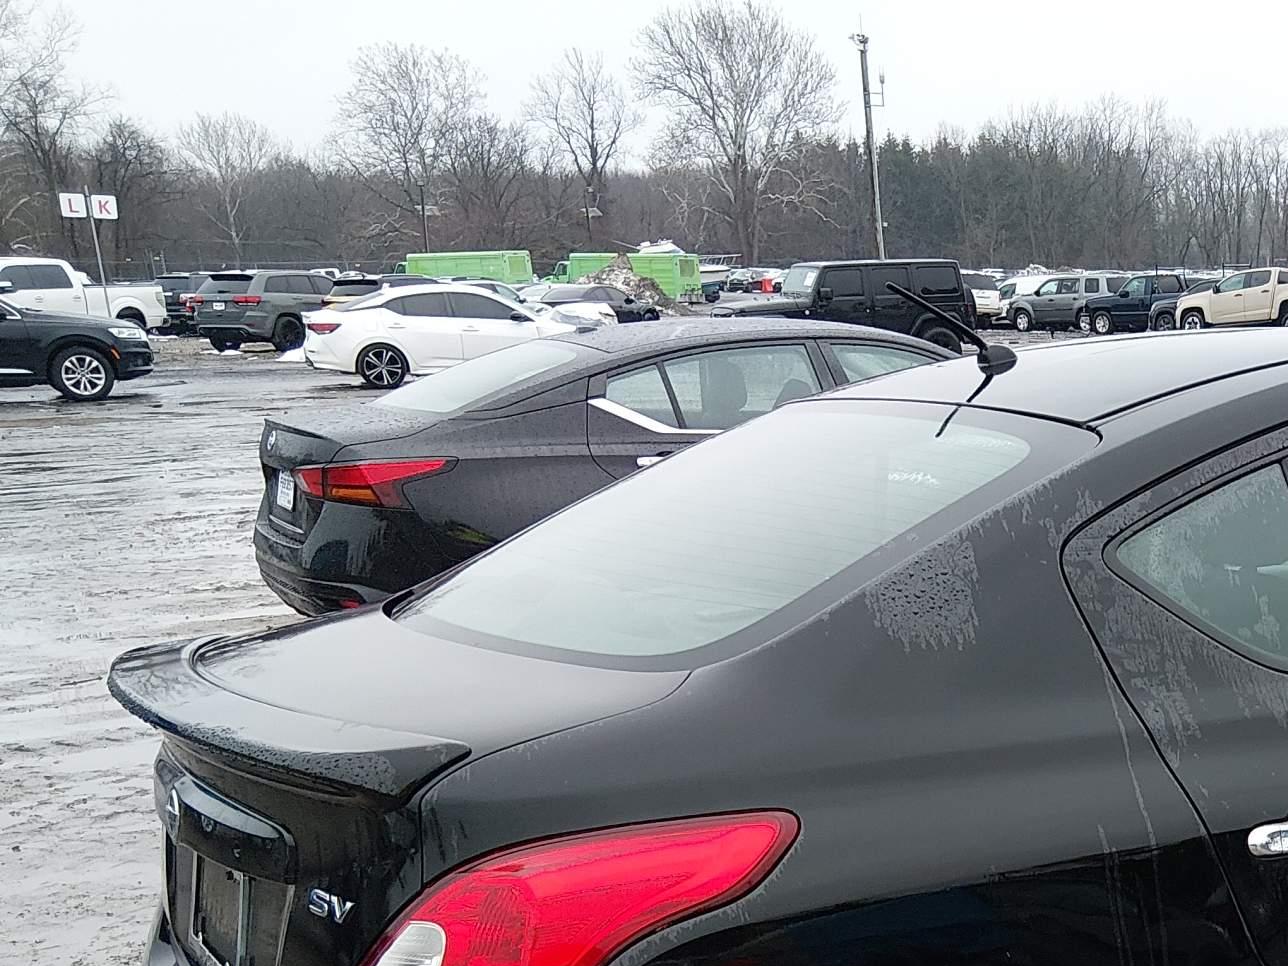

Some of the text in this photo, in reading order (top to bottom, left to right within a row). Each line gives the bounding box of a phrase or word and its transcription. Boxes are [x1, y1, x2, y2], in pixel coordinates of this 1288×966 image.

[68, 198, 80, 213] L
[98, 199, 112, 215] K
[309, 888, 356, 924] SV
